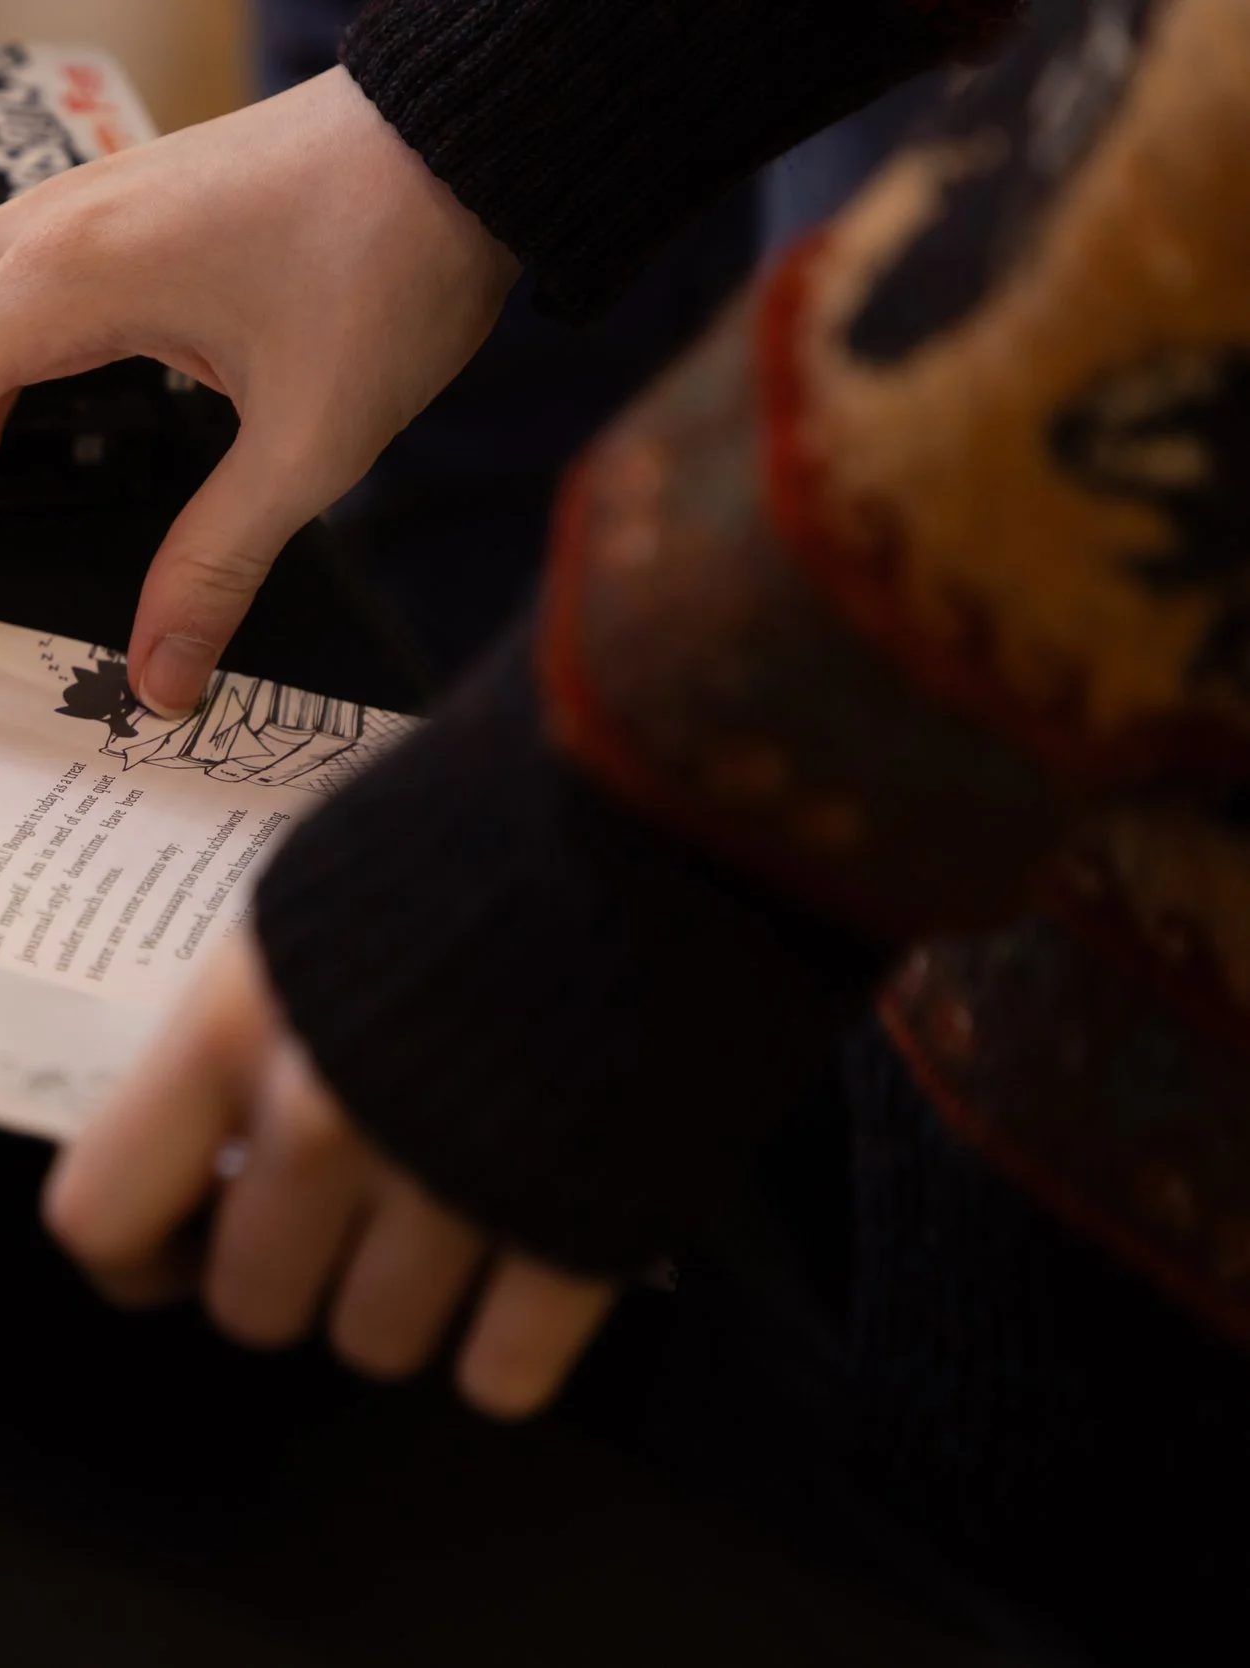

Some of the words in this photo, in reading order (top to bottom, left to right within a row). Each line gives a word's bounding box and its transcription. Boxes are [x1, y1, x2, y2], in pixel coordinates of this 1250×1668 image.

[65, 778, 73, 786] a
[67, 761, 87, 780] treat
[53, 783, 67, 794] as
[92, 774, 117, 795] quiet
[33, 790, 65, 816] today
[75, 794, 99, 816] some
[24, 811, 44, 823] it
[64, 814, 82, 826] of
[2, 820, 37, 853] Bought
[49, 825, 73, 848] need
[228, 811, 291, 870] home-schooling
[34, 848, 56, 861] in
[179, 872, 199, 888] too
[191, 849, 216, 874] much
[207, 809, 249, 851] schoolwork.
[14, 881, 73, 969] journal-style
[62, 832, 109, 879] downtime.
[99, 809, 127, 831] Have
[117, 788, 144, 808] been
[22, 861, 47, 882] Am
[224, 864, 244, 884] am
[0, 883, 32, 928] myself.
[203, 885, 230, 913] since
[54, 929, 84, 973] under
[77, 897, 104, 932] much
[97, 866, 124, 899] stress.
[85, 944, 117, 982] Here
[107, 924, 128, 945] are
[118, 894, 144, 928] some
[136, 861, 167, 897] reasons
[157, 842, 184, 863] why:
[175, 911, 215, 961] Granted,
